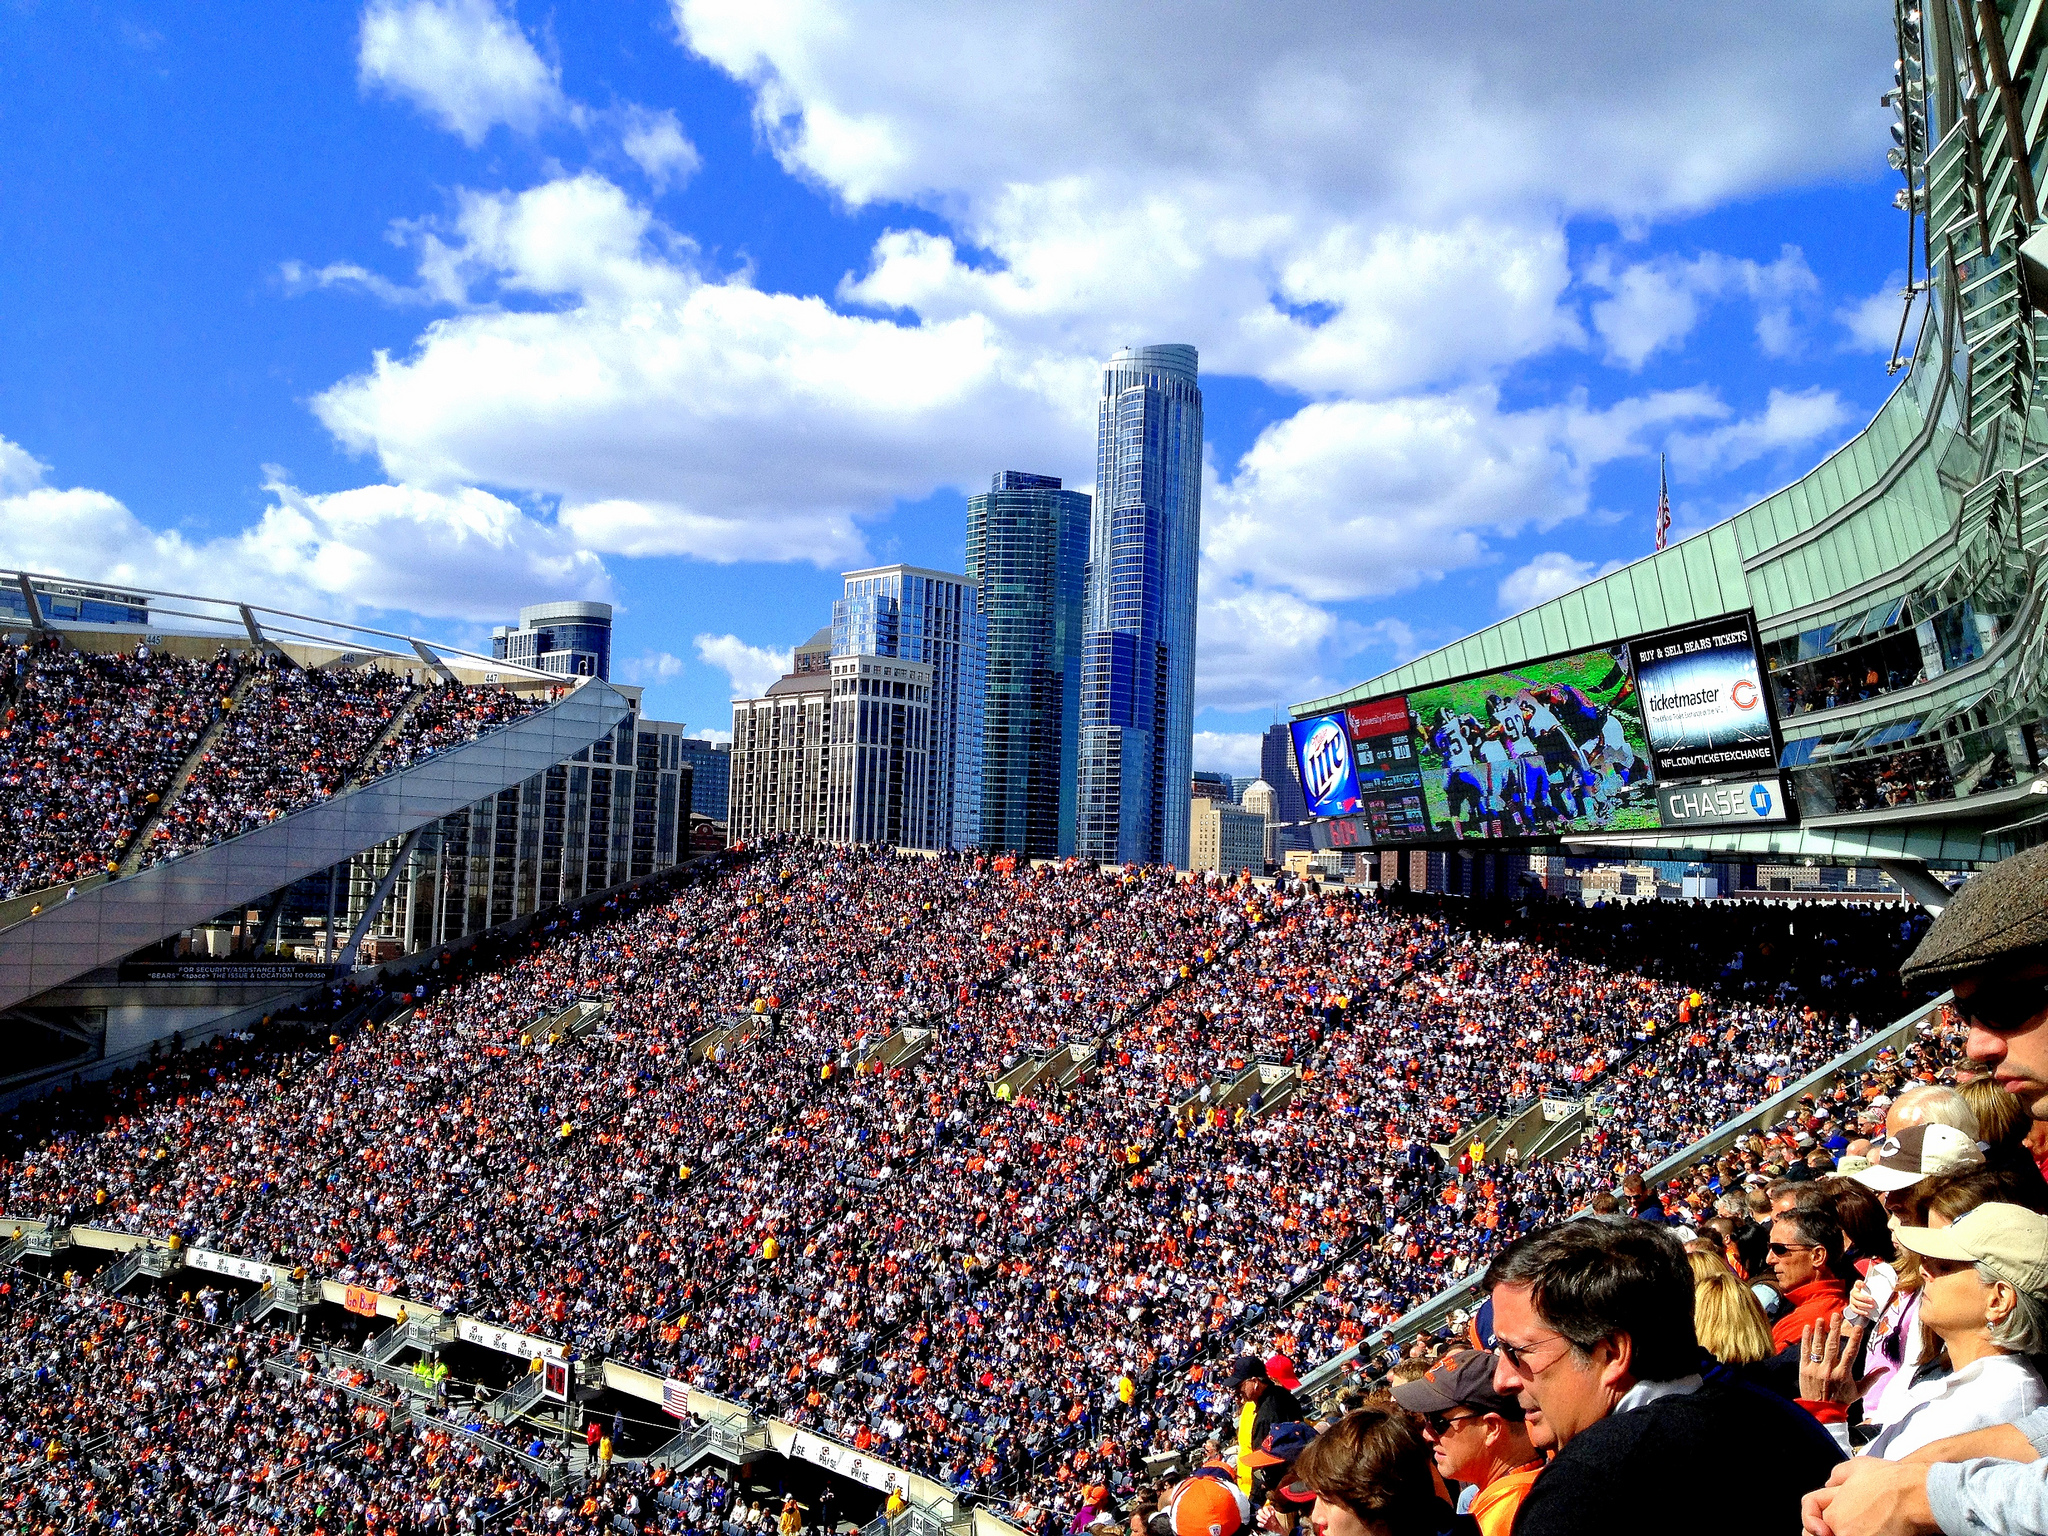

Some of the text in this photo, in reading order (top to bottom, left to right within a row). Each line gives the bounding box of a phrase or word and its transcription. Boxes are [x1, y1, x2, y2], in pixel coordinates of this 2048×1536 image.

[146, 636, 160, 644] 445
[1639, 630, 1748, 662] BUY & SELL BEARS TICKETS
[342, 654, 354, 663] 446
[486, 674, 497, 682] 447
[1650, 688, 1719, 712] ticketmaster
[1661, 748, 1771, 768] NFL.COM/TICKETEXCHANGE
[1670, 790, 1748, 819] CHASE
[1545, 1102, 1556, 1113] 354
[347, 1289, 357, 1307] Go
[712, 1430, 722, 1443] 153
[792, 1443, 805, 1456] ASE
[914, 1516, 922, 1532] 154
